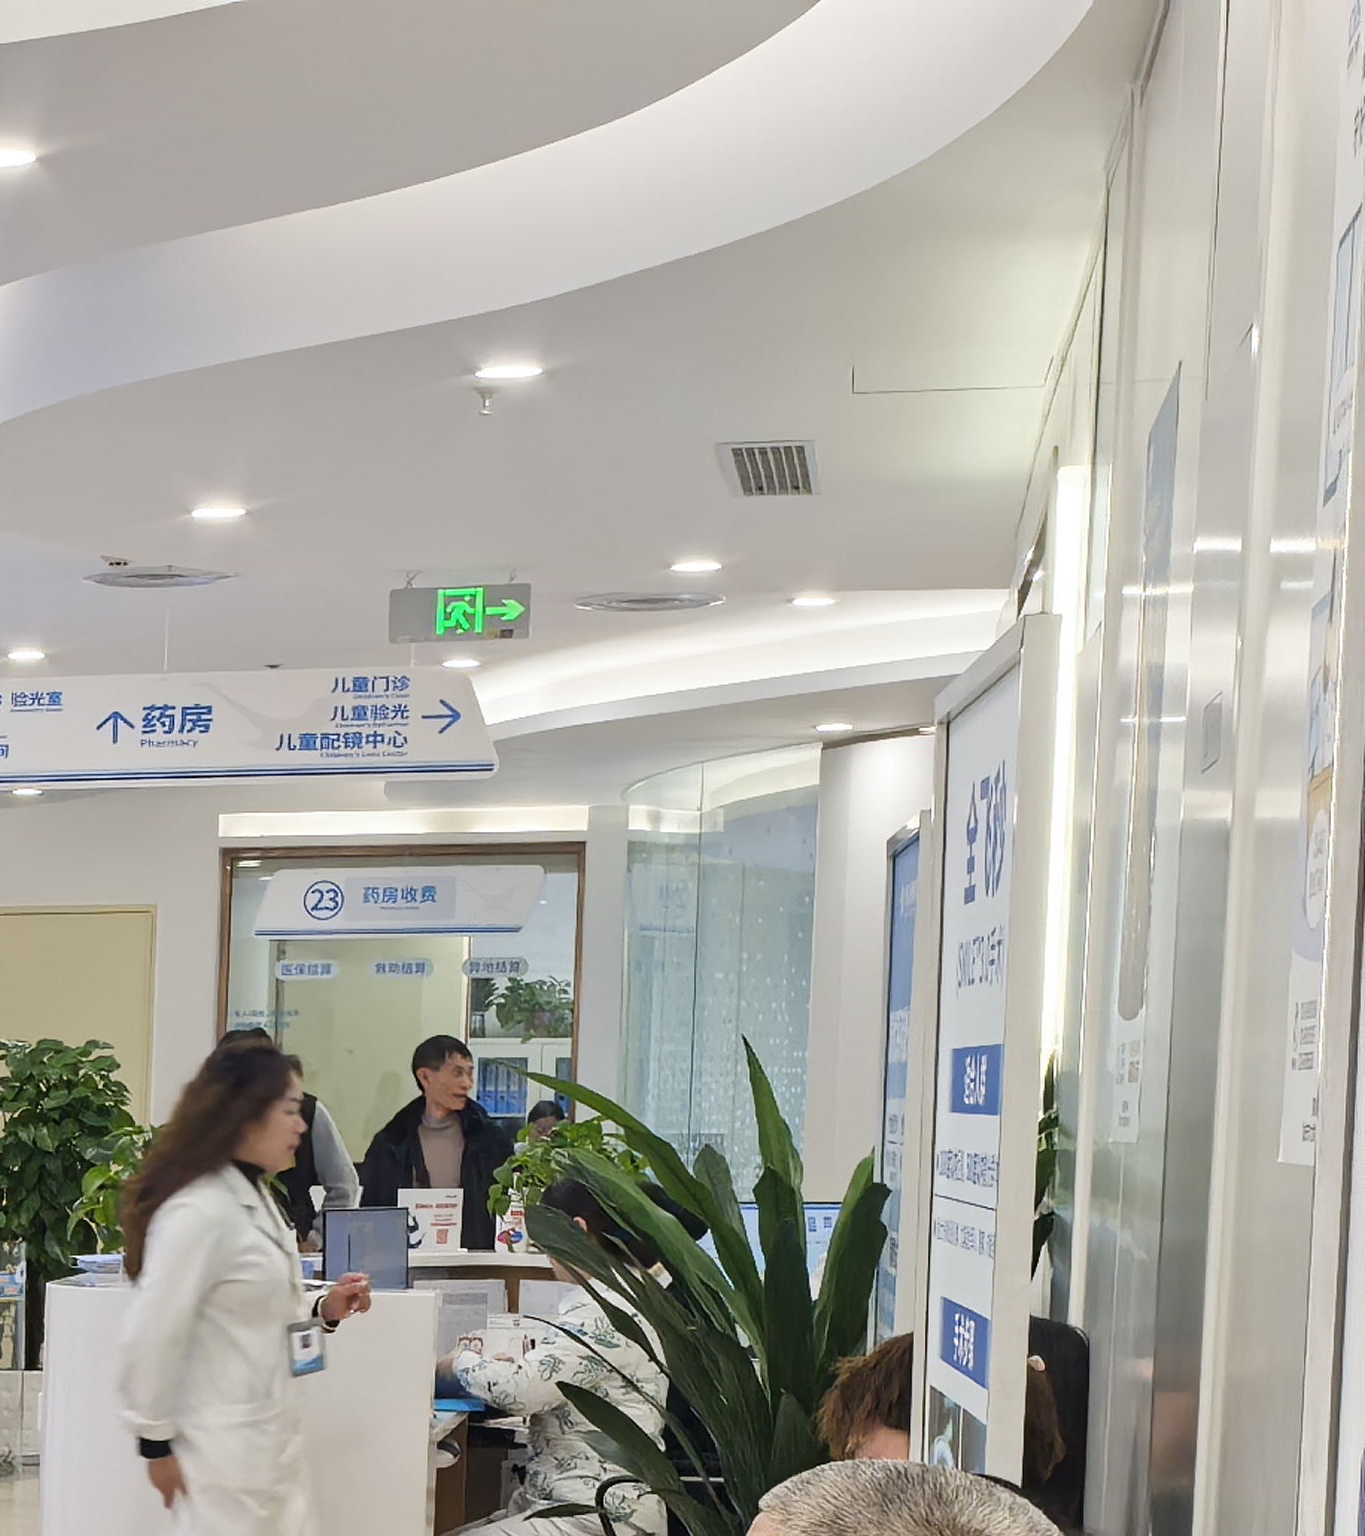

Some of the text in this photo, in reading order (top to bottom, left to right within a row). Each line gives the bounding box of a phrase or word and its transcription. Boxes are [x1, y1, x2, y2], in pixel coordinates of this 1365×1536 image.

[330, 675, 411, 693] 儿童门诊
[10, 690, 64, 708] 验光室
[141, 704, 214, 734] 药房
[329, 703, 411, 721] 儿童验光
[275, 730, 409, 752] 儿童配镜中心
[963, 758, 1007, 906] 全飞秒
[310, 885, 439, 913] 23 药房收费
[281, 962, 333, 976] 医保结算
[374, 962, 426, 975] 救助结算
